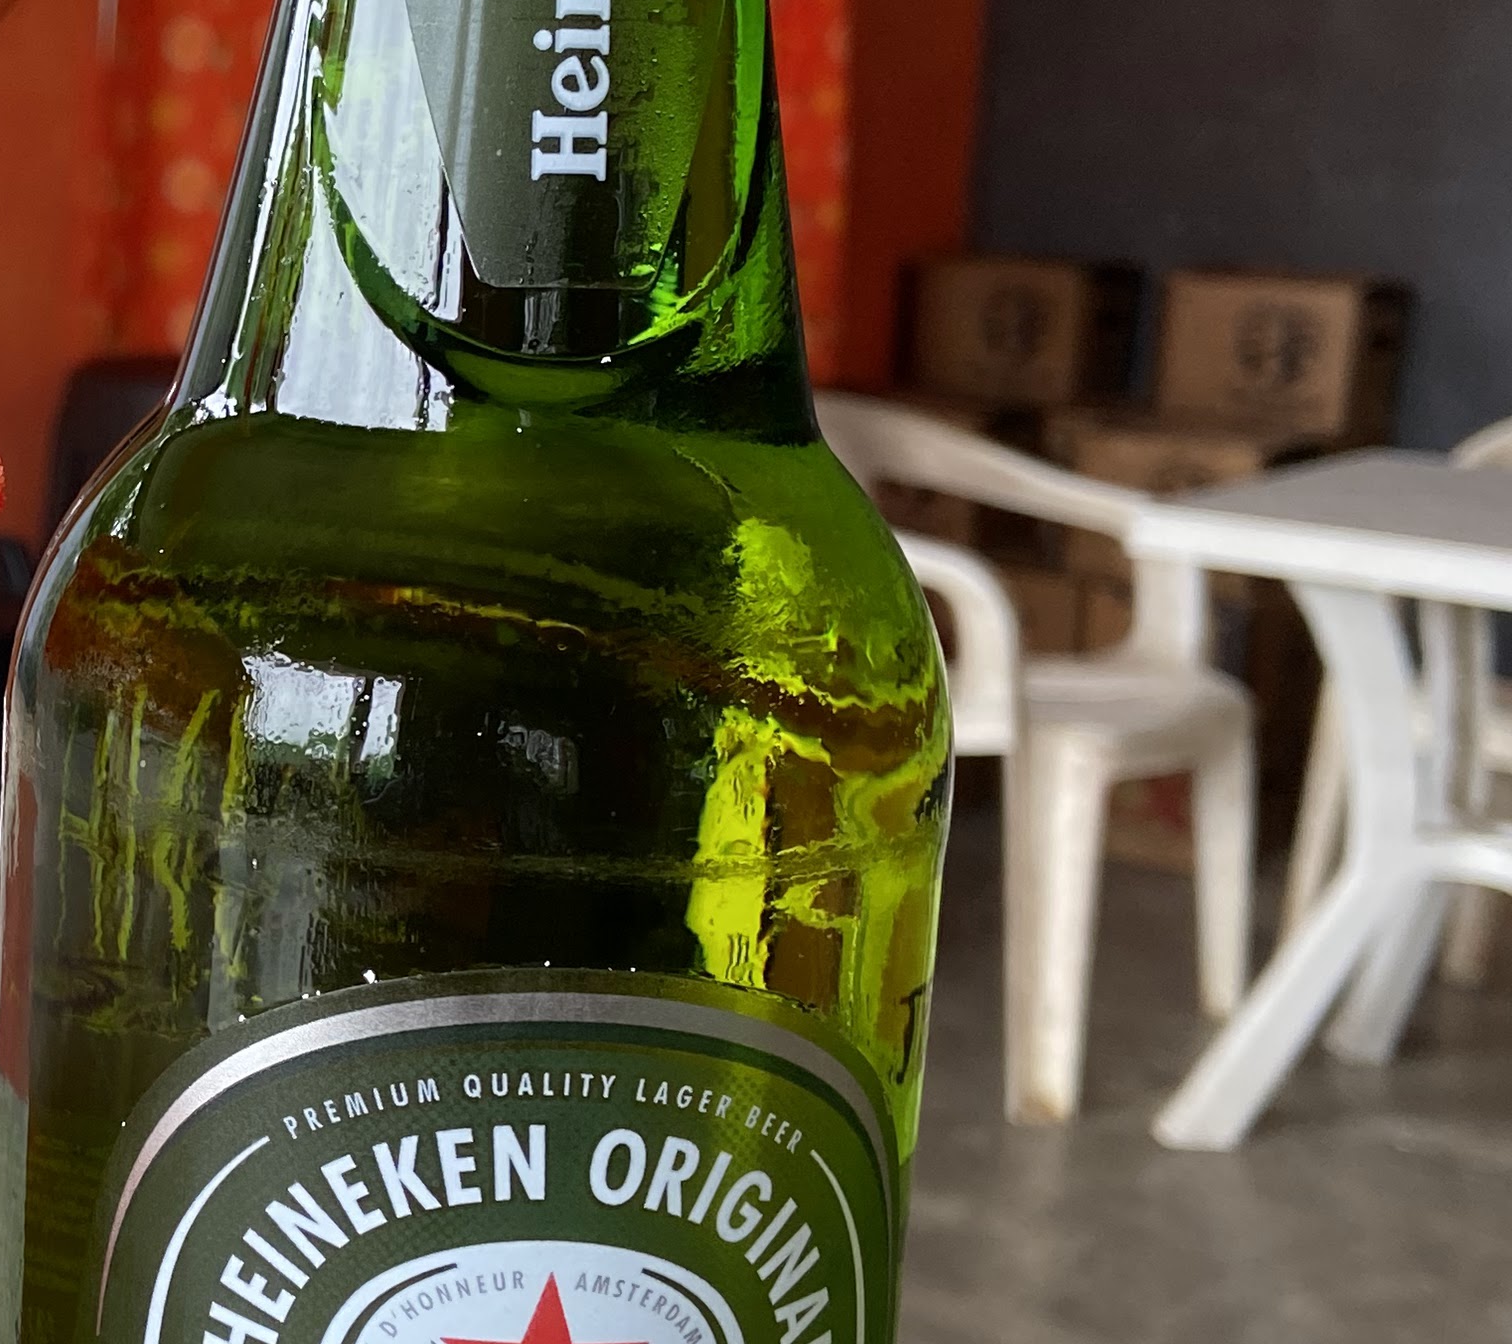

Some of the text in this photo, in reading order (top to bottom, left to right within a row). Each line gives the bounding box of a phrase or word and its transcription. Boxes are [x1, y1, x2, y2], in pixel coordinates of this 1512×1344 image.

[282, 1072, 804, 1155] PREMIUM QUALITY LAGER BEER
[378, 1270, 525, 1338] D'HONNEUR
